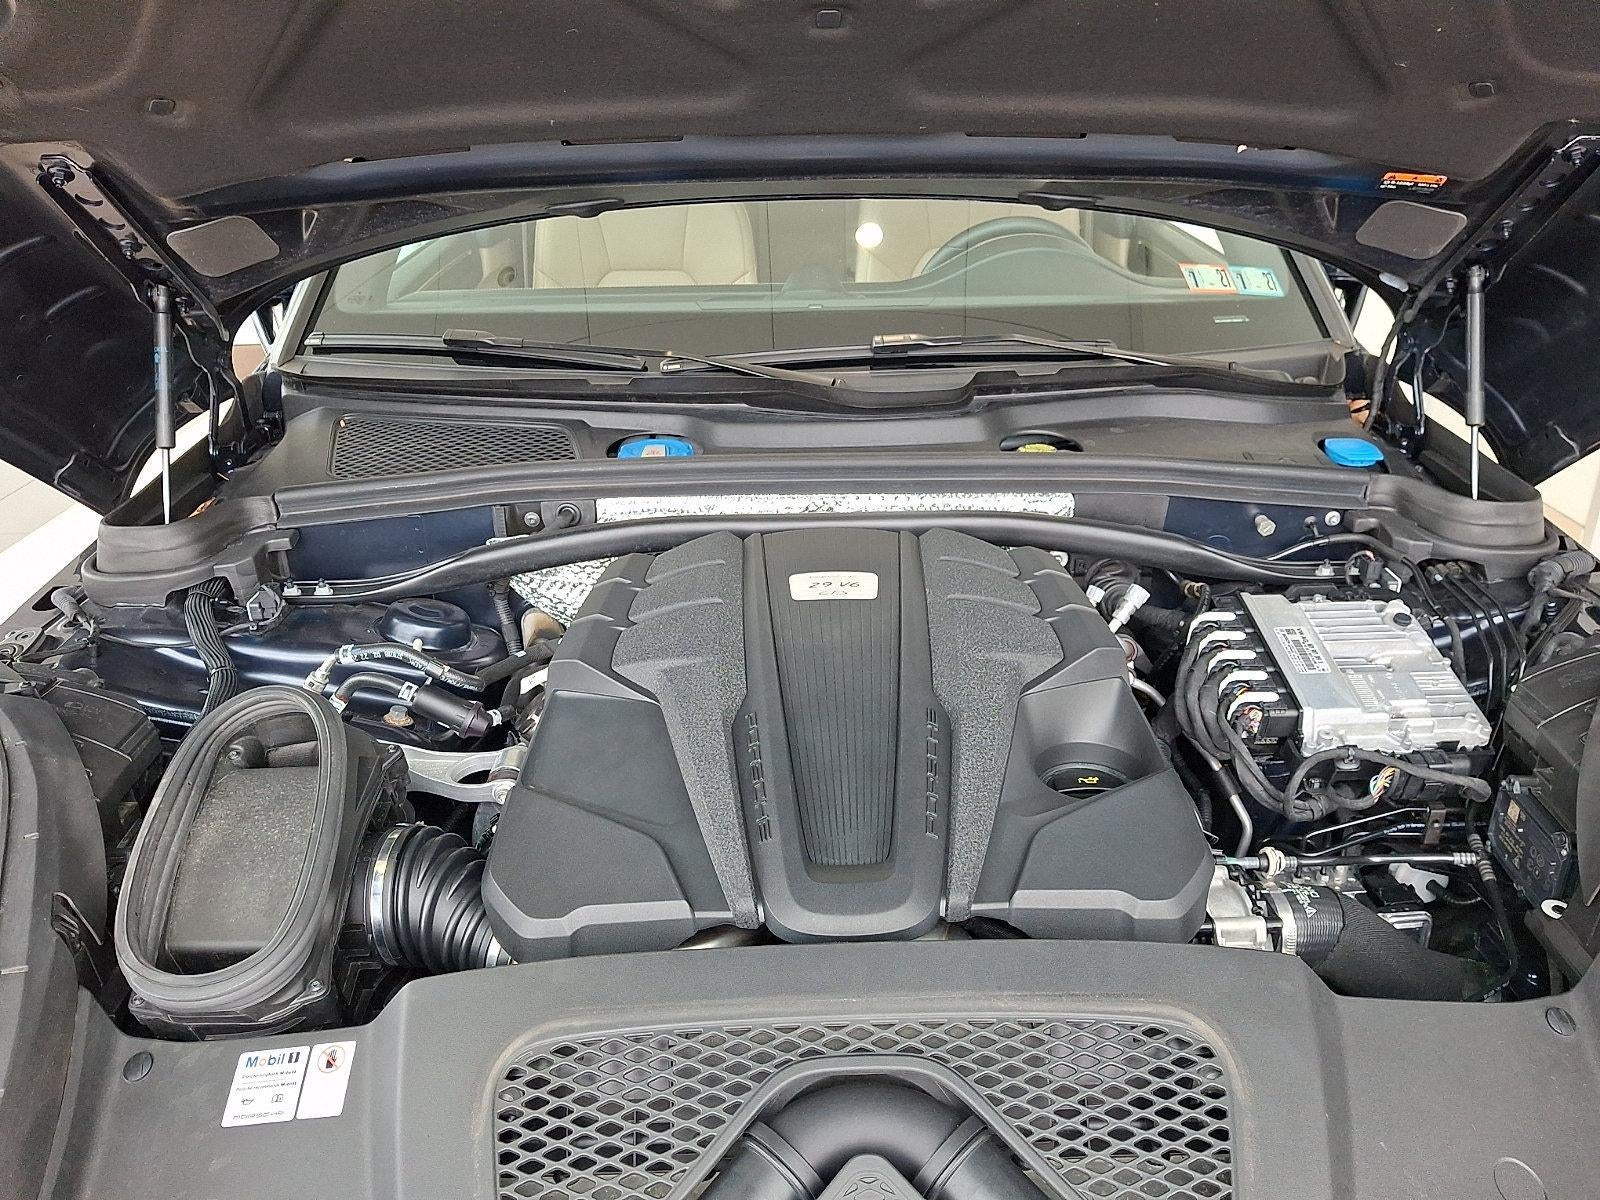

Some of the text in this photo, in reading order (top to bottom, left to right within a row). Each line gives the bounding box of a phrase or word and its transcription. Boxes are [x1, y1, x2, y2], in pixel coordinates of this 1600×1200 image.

[744, 711, 772, 844] PORSCHE
[925, 706, 940, 840] PORSCHE
[245, 1051, 301, 1068] Mobil 1
